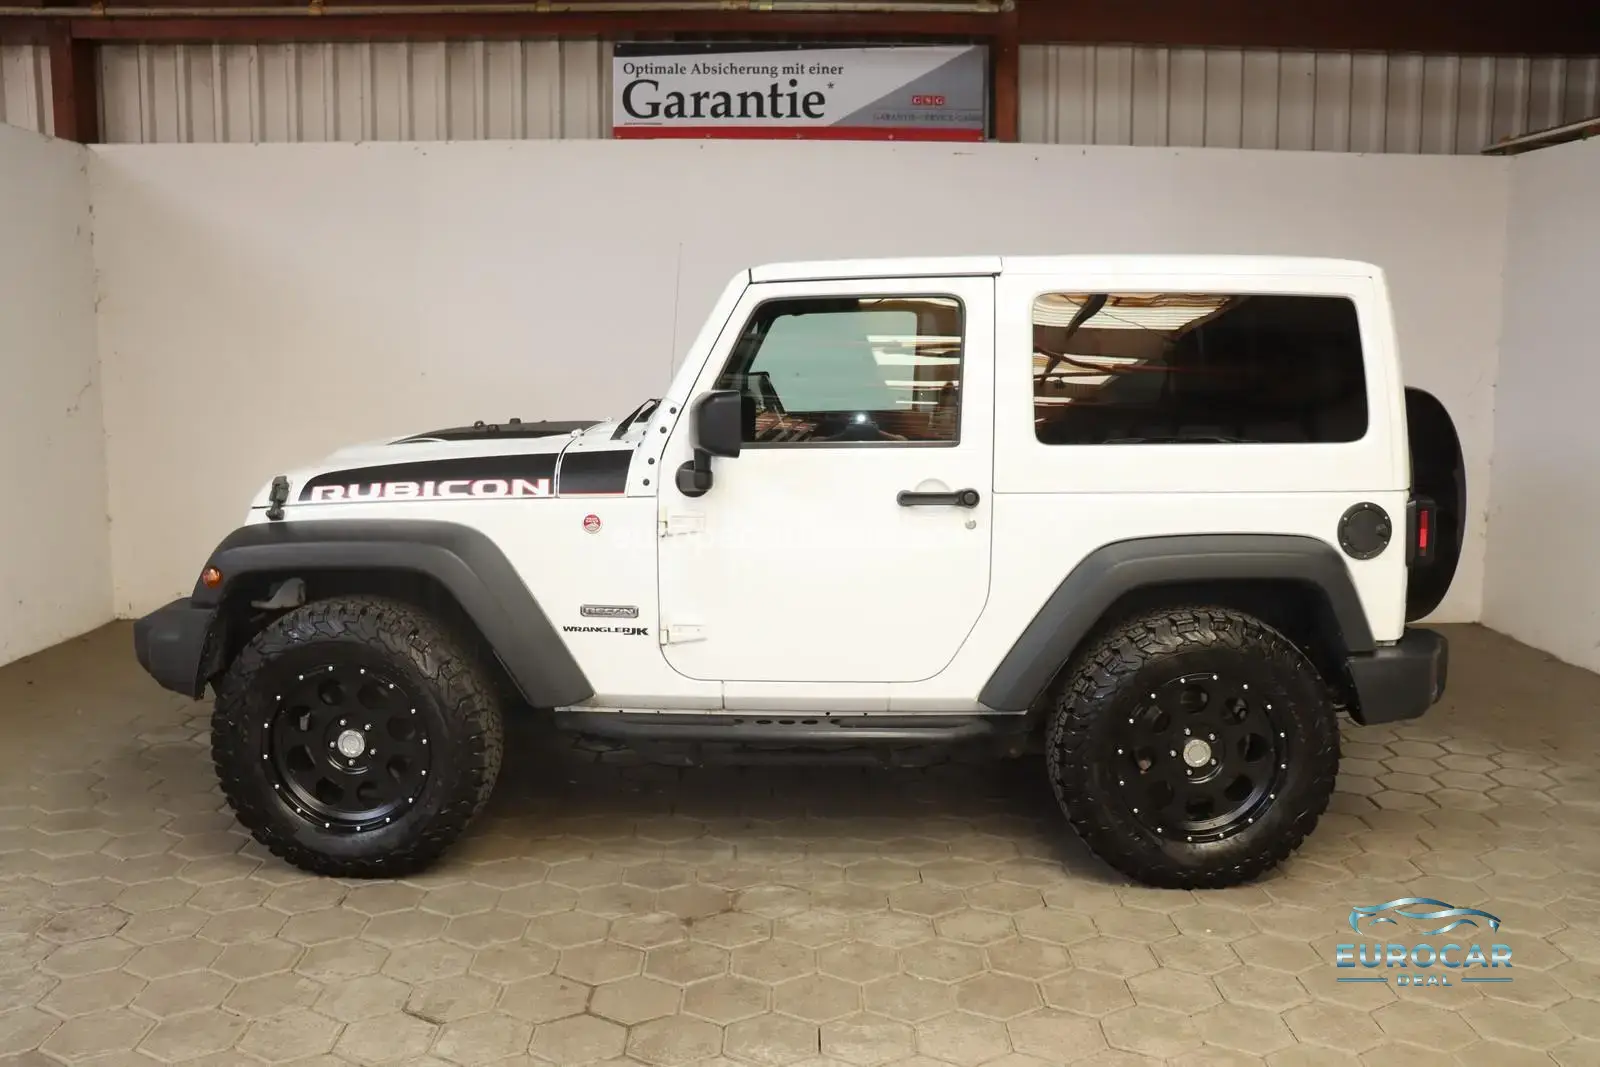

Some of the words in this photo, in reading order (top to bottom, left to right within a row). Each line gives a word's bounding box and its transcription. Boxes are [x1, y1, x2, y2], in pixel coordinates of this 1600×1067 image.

[623, 62, 687, 77] Optimale
[690, 62, 779, 78] Absicherung
[782, 62, 805, 75] mit
[808, 62, 844, 75] einer
[311, 478, 550, 501] RUBICON
